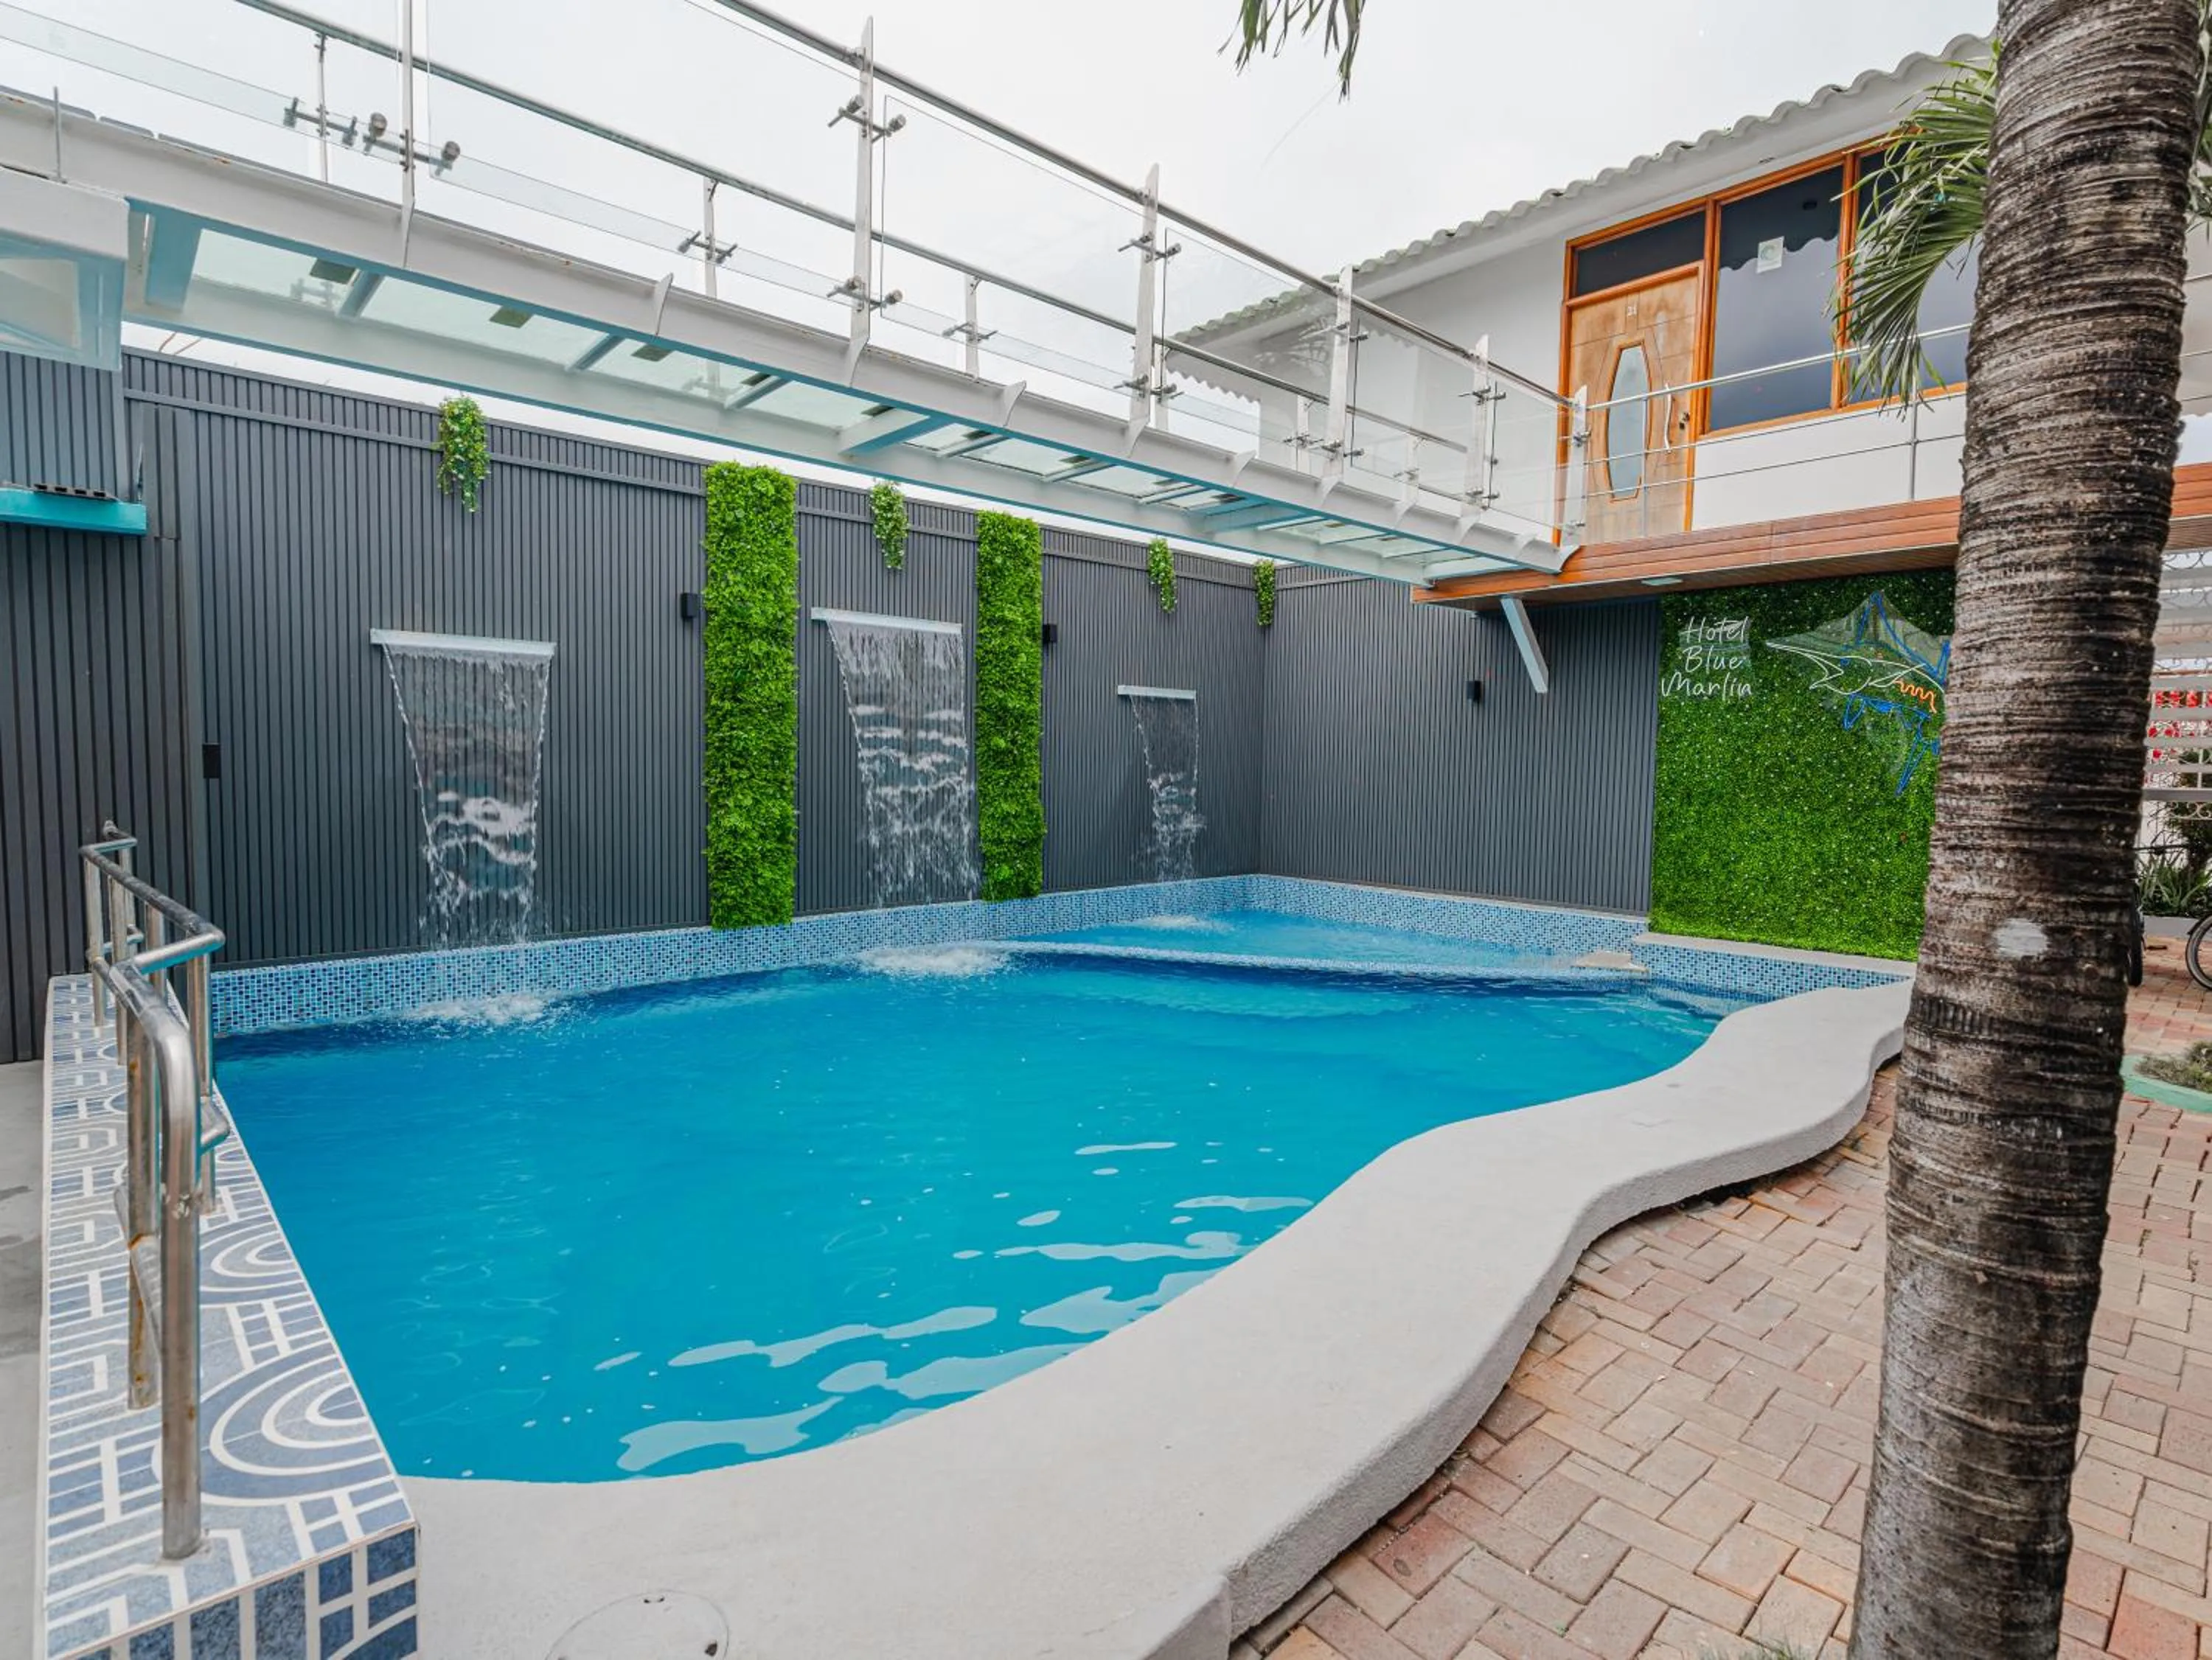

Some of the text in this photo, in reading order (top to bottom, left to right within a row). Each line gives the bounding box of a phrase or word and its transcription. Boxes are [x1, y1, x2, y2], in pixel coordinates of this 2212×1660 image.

[1680, 615, 1749, 644] Hotel
[1682, 645, 1745, 674] Blue
[1661, 672, 1753, 701] Marlin
